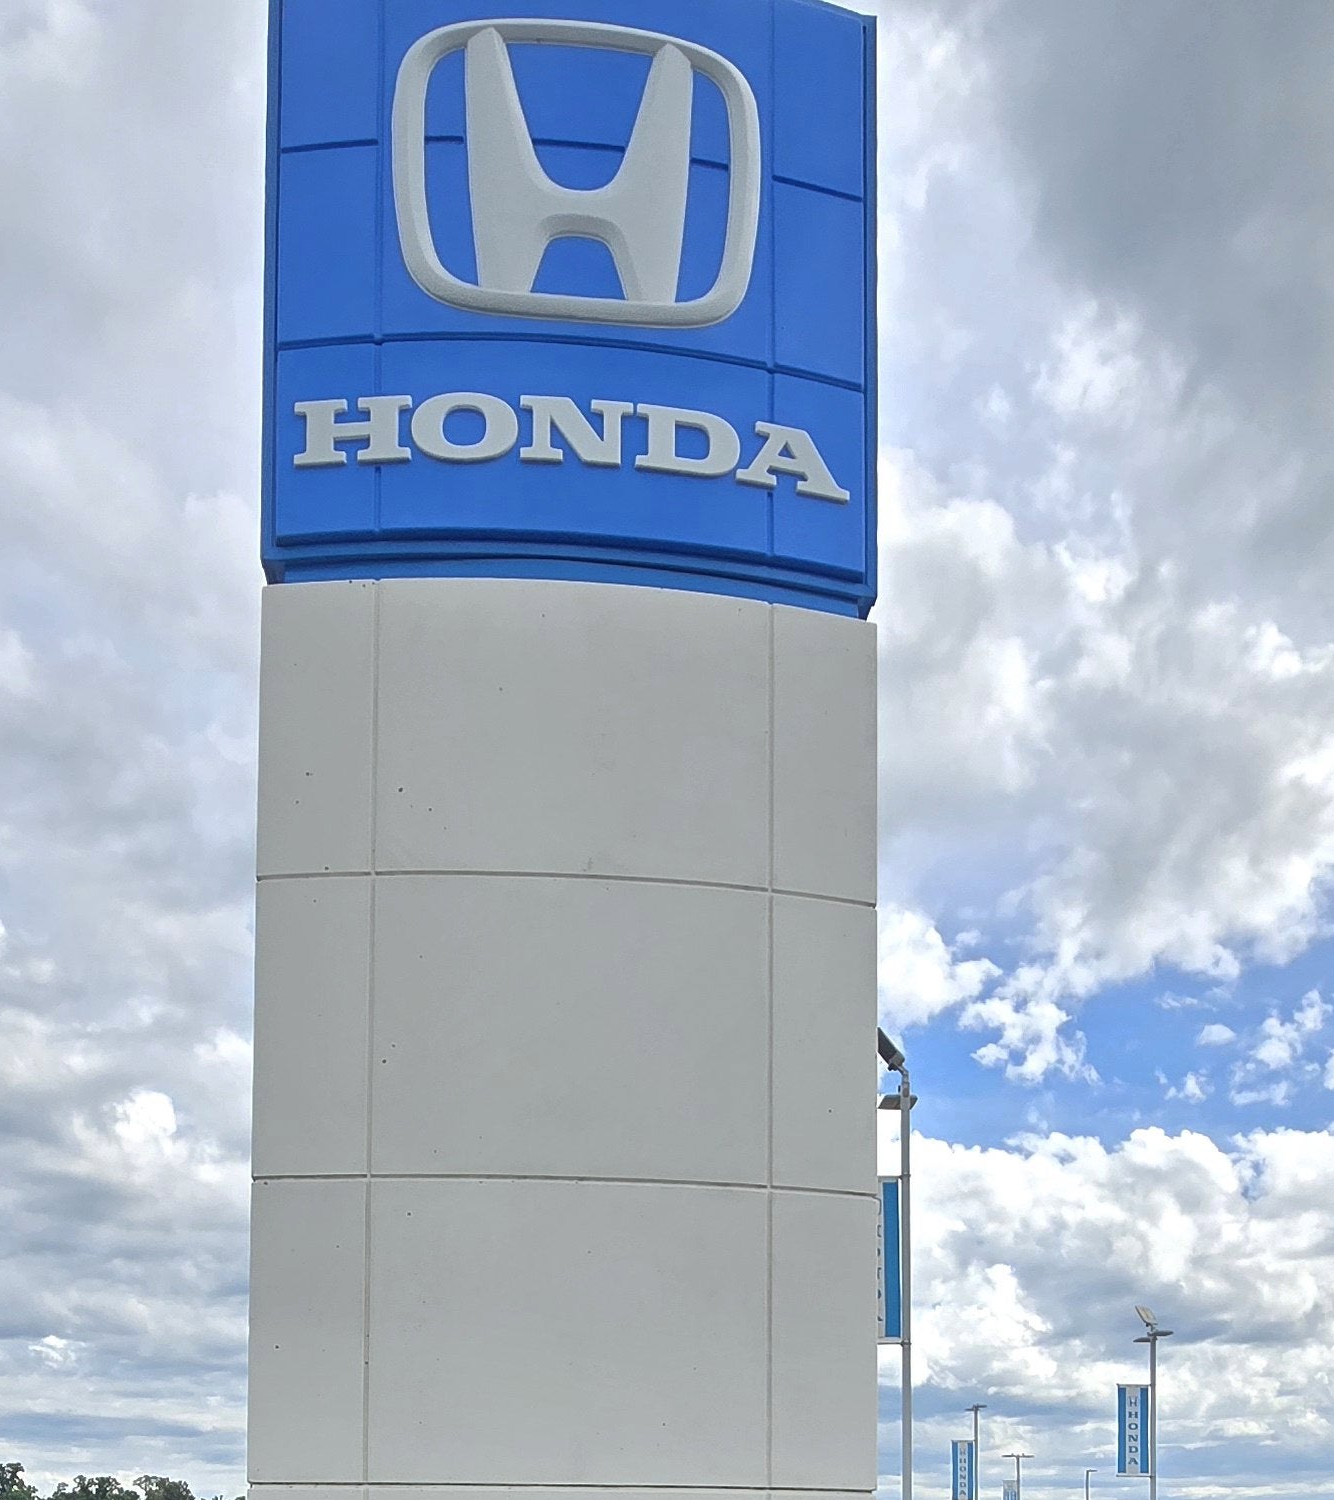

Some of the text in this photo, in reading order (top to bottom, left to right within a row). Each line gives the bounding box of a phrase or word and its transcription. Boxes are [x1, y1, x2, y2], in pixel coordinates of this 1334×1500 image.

[293, 391, 850, 503] HONDA
[1128, 1411, 1139, 1465] HONDA
[959, 1457, 967, 1496] HONDA
